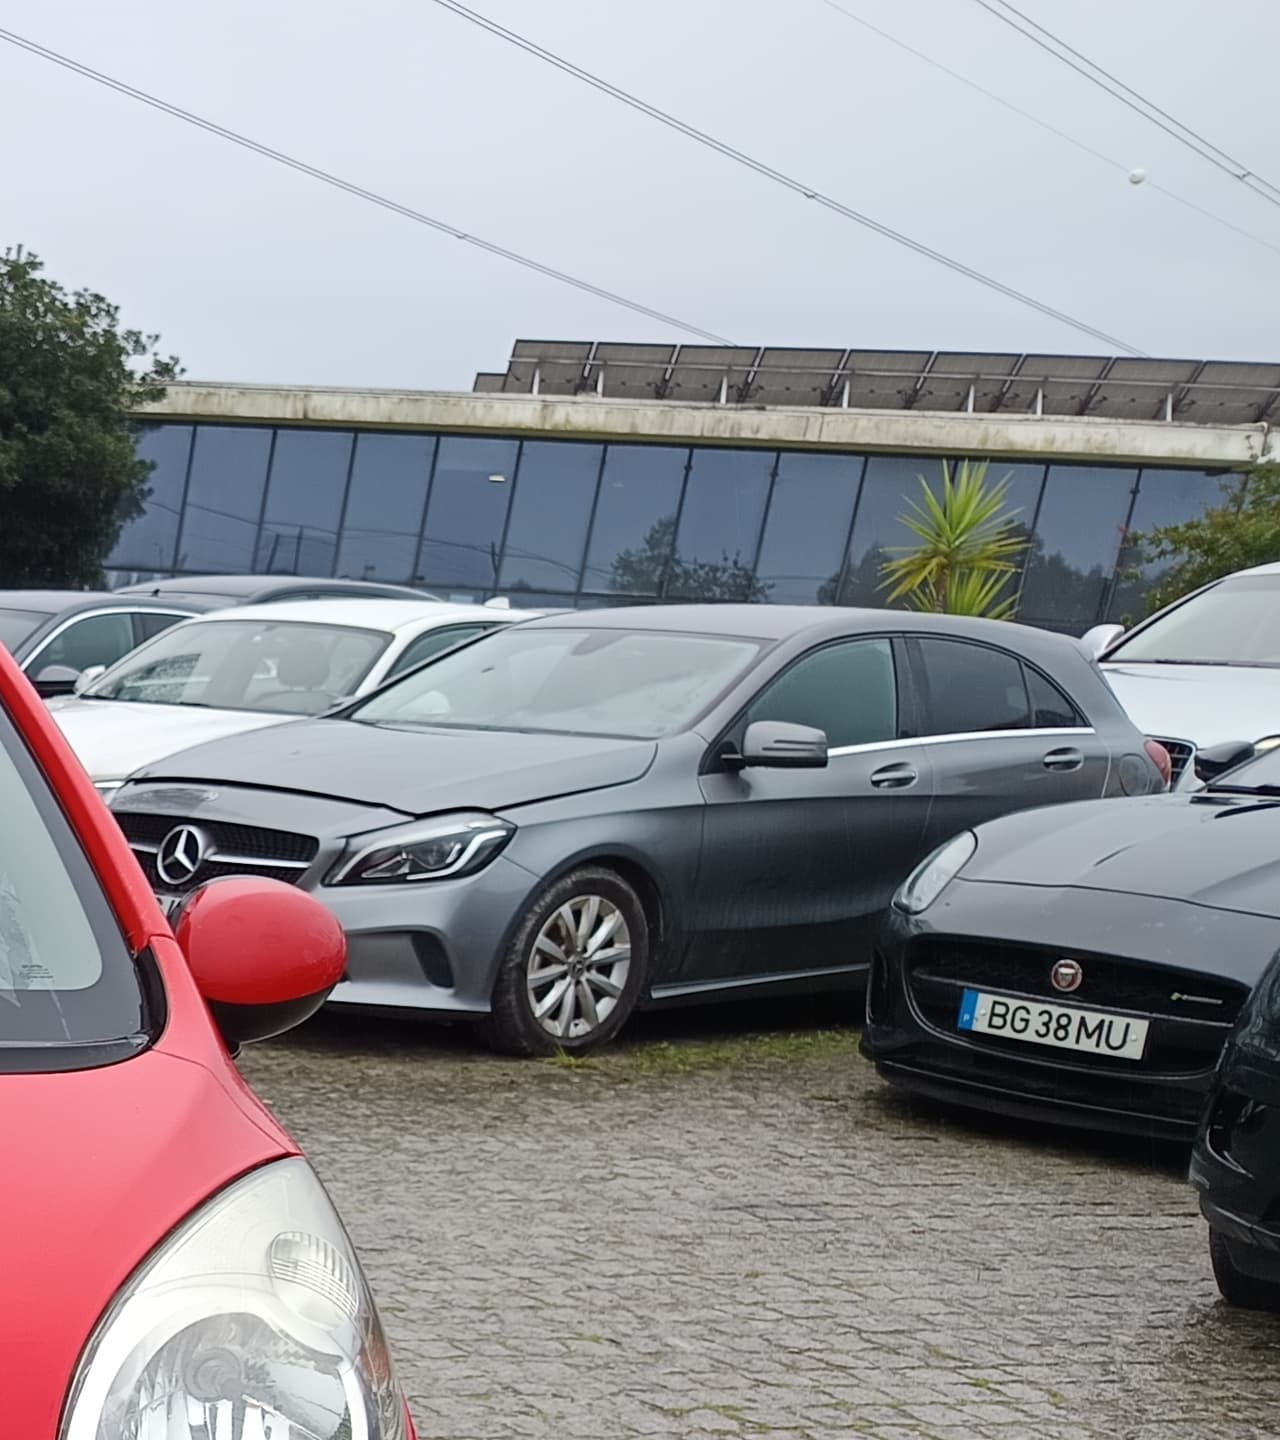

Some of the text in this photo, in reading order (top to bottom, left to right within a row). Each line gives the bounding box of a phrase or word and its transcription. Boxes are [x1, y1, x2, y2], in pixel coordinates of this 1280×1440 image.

[988, 1000, 1131, 1051] BG 38 MU
